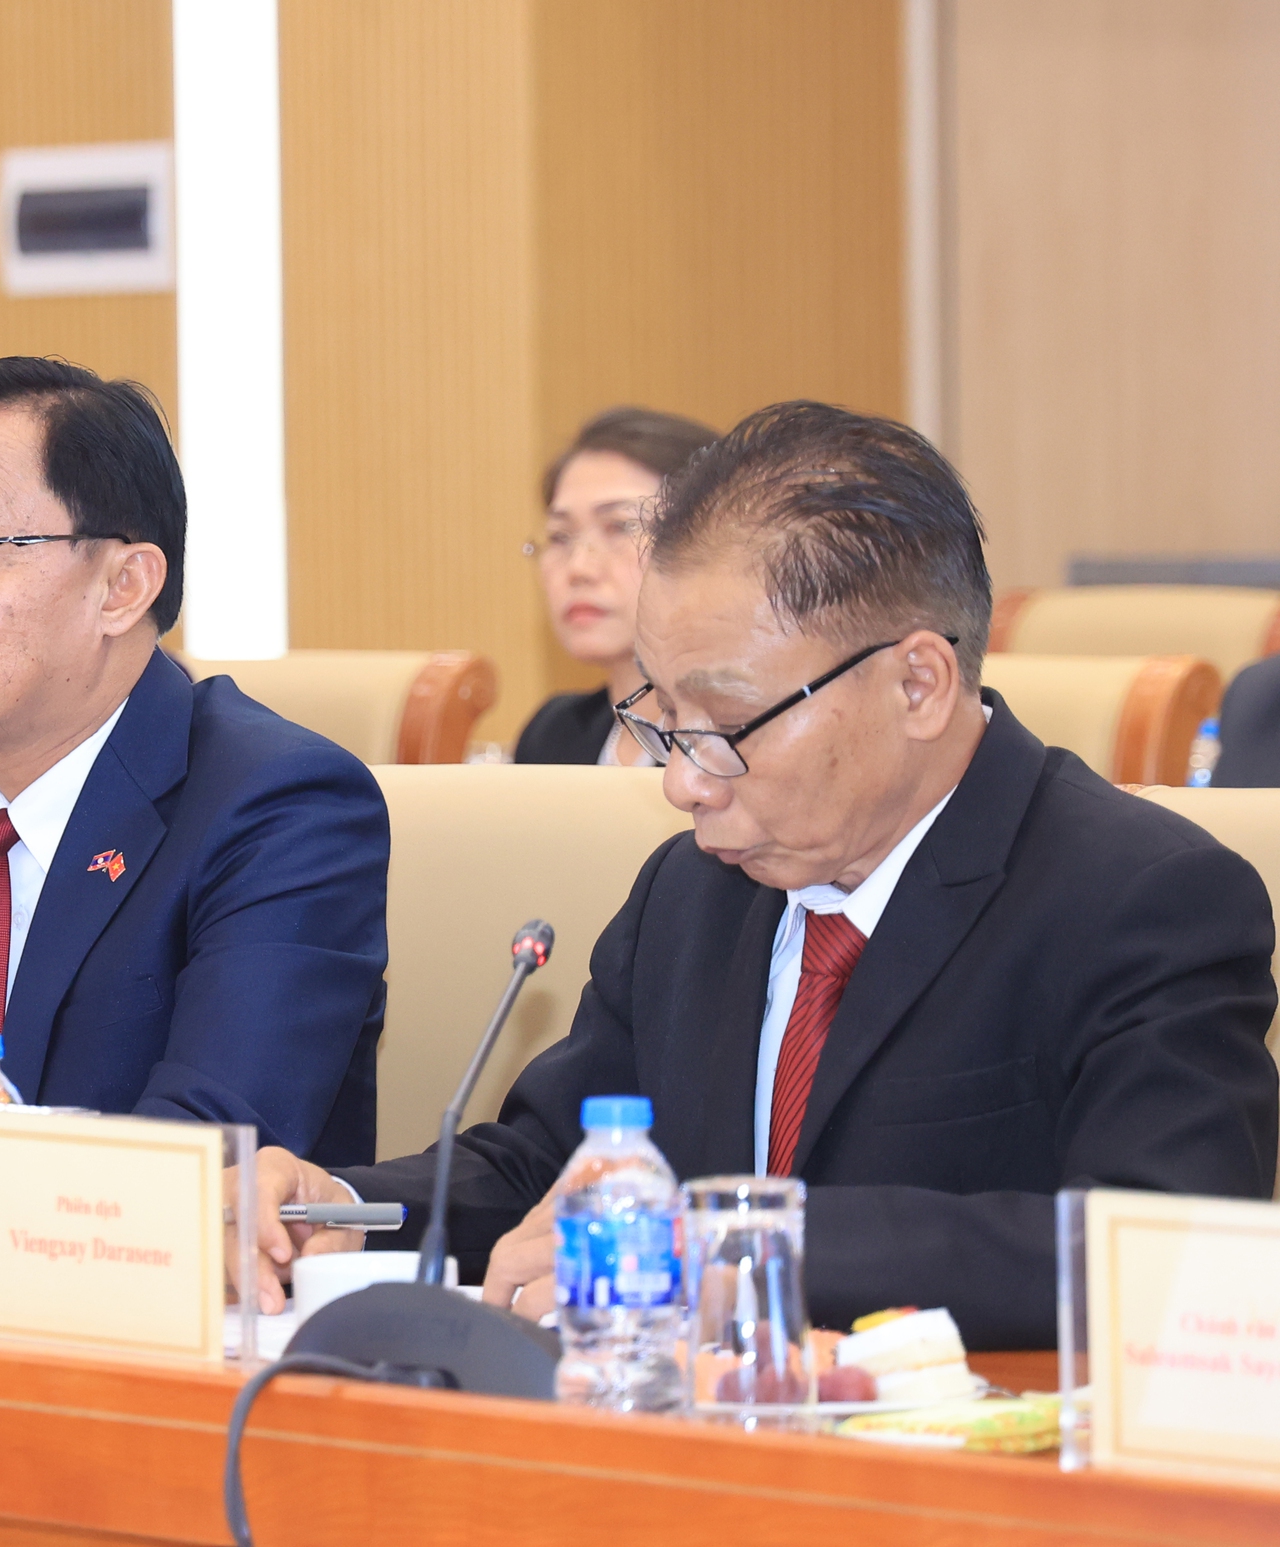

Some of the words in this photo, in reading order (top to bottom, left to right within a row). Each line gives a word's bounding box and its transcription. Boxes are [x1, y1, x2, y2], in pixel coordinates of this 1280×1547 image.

[56, 1195, 92, 1215] Phiên
[95, 1198, 122, 1220] dịch
[9, 1228, 87, 1264] Viengxay
[92, 1236, 173, 1267] Darasene
